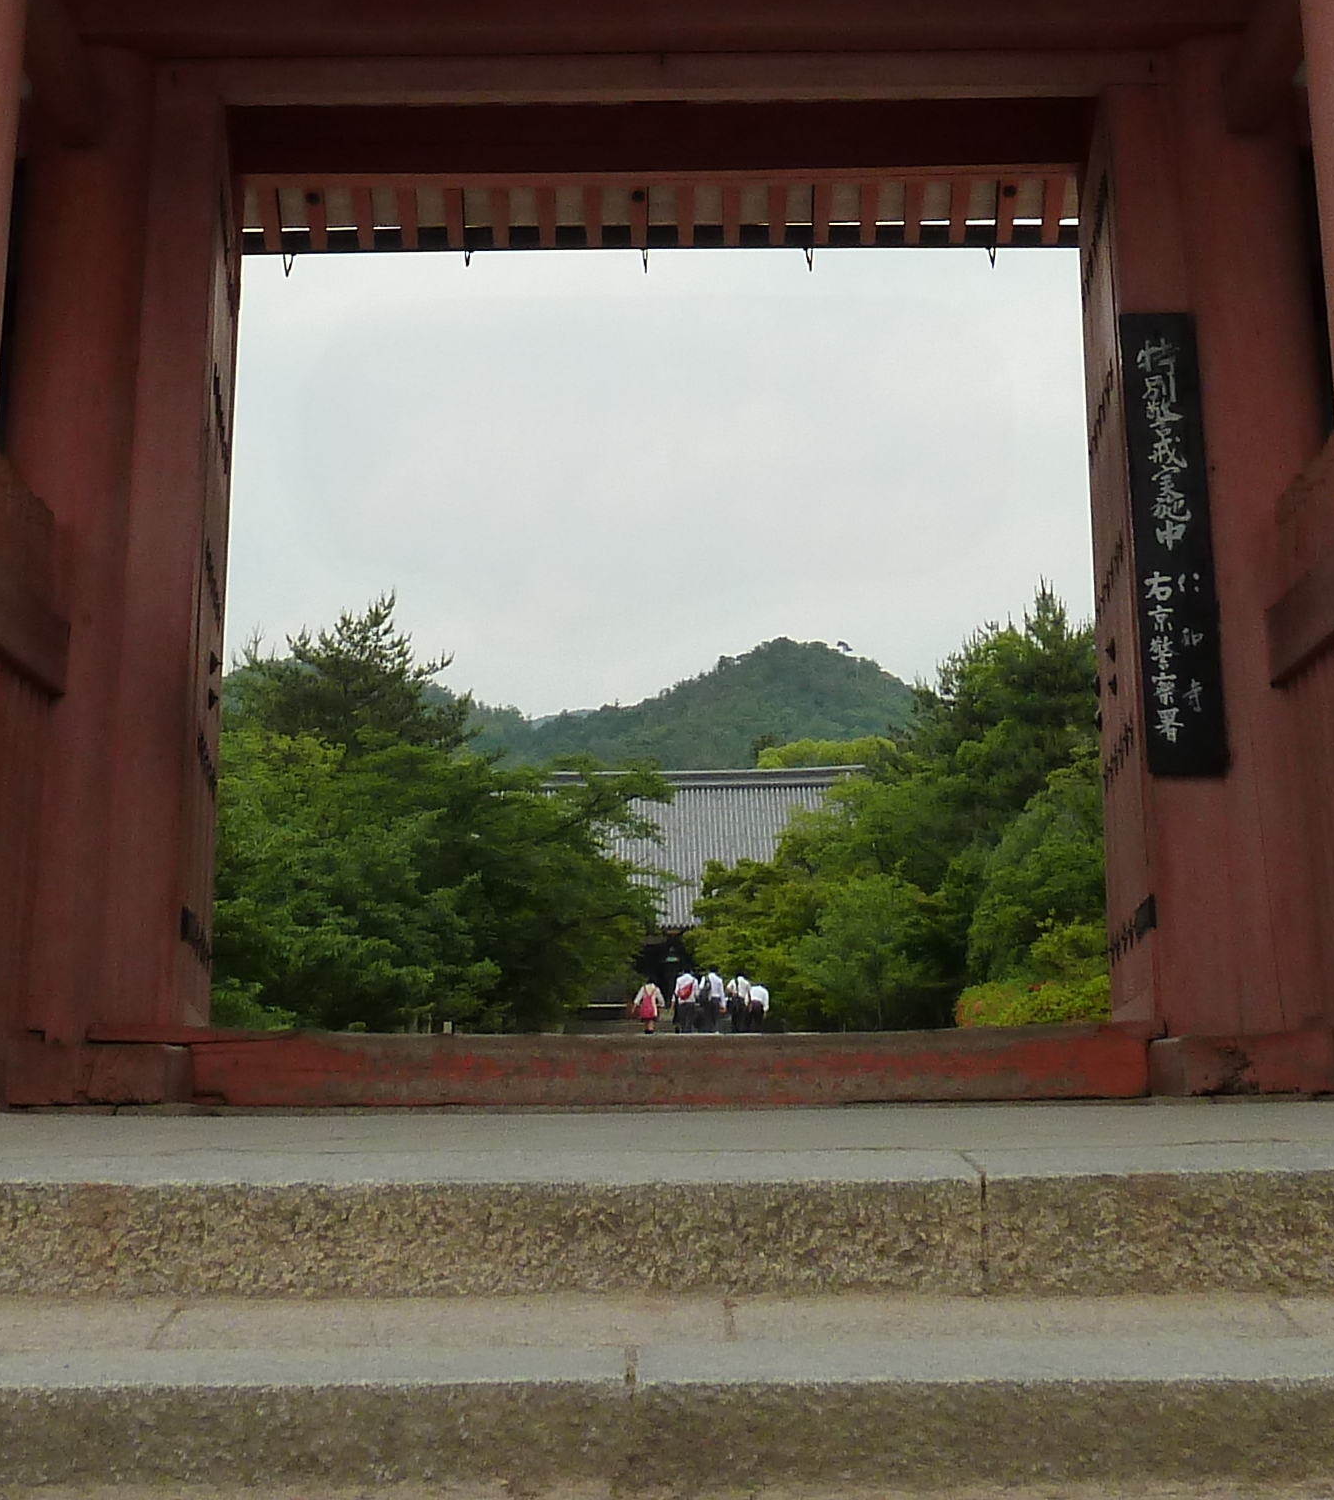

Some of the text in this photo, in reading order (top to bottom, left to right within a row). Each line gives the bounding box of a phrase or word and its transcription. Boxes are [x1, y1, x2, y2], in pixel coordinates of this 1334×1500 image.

[1135, 337, 1192, 551] 特別警戒実施中
[1143, 570, 1185, 744] 右京警察署
[1177, 572, 1204, 713] 仁和寺
